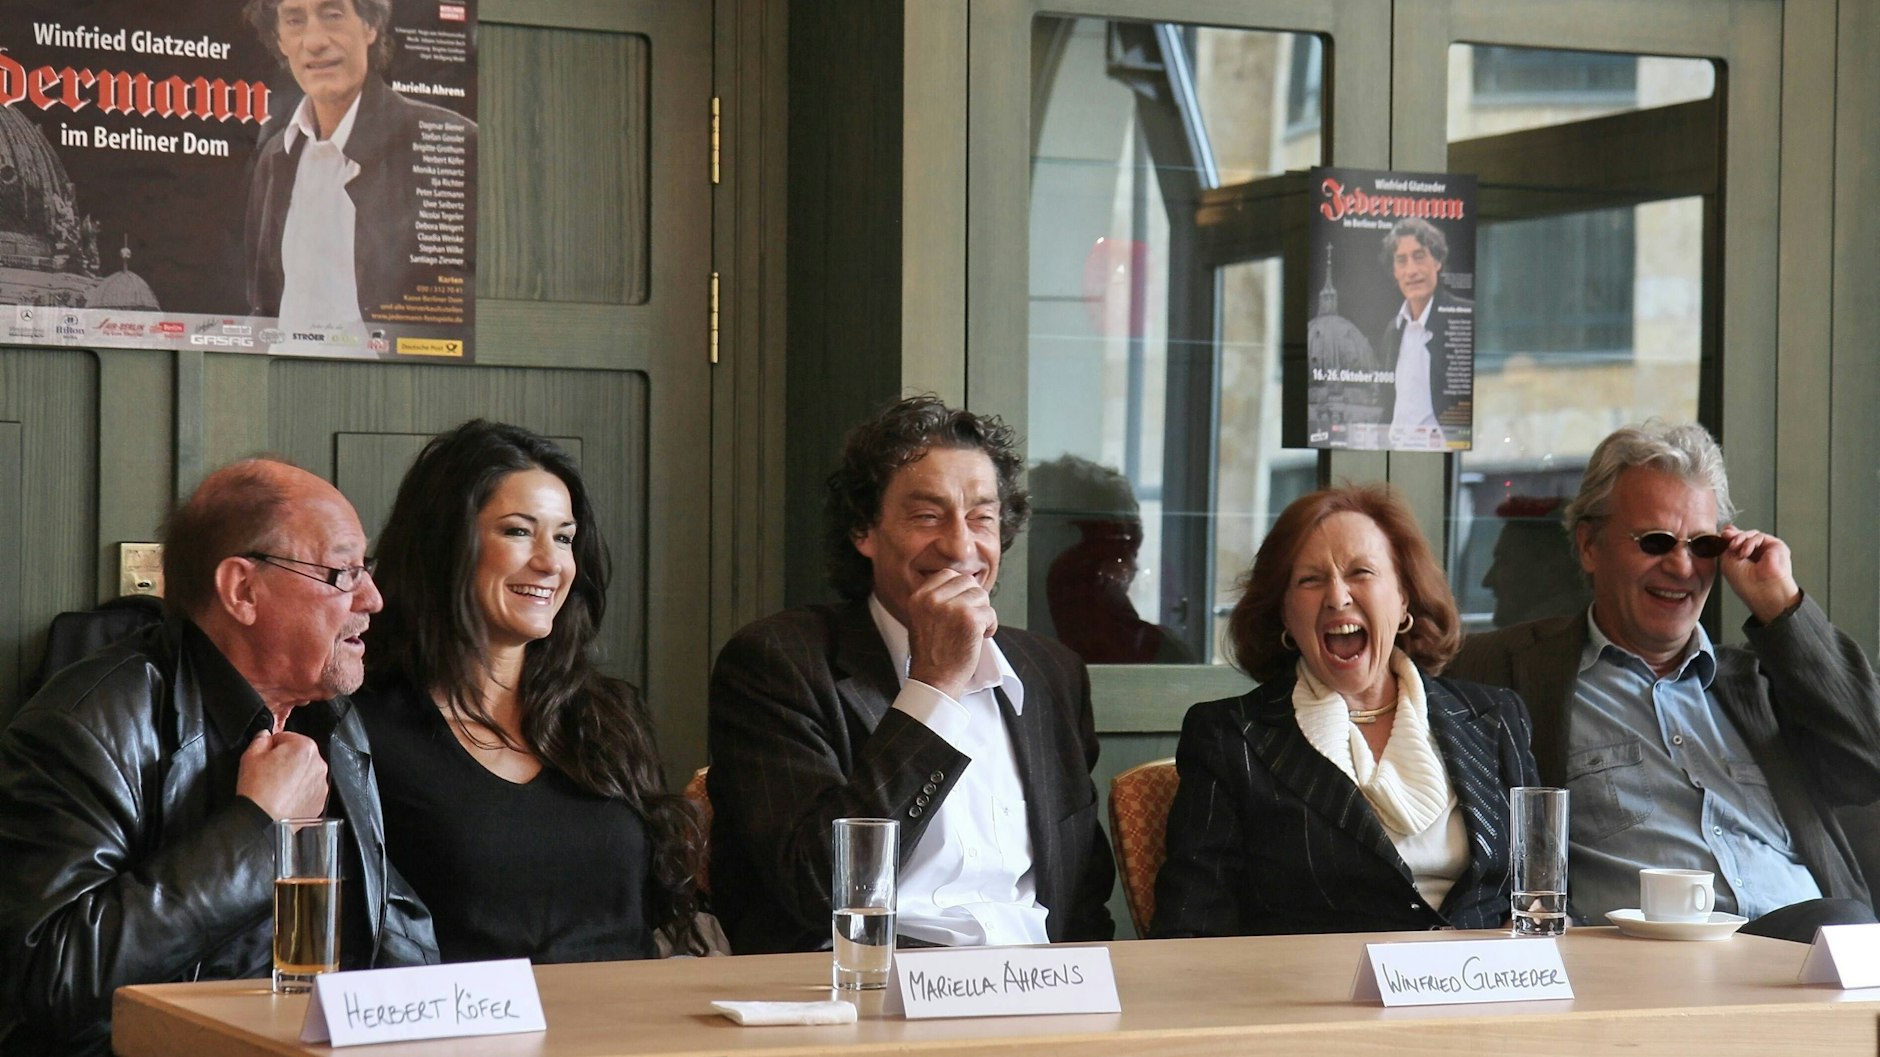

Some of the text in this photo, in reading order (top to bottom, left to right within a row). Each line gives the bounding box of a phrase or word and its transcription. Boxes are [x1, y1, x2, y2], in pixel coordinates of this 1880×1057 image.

[33, 22, 231, 59] Winfried Glatzeder
[392, 80, 465, 97] Mariella Ahrens
[60, 123, 230, 157] im Berliner Dom
[422, 155, 447, 164] Herbert
[412, 164, 436, 175] Monika
[442, 178, 464, 188] Richter
[1375, 179, 1446, 193] Winfried Glatzeder
[416, 187, 432, 196] Peter
[423, 199, 437, 208] Uwe
[1320, 177, 1464, 222] Jedermann
[1353, 218, 1377, 229] Berliner
[1378, 220, 1393, 229] Dom
[417, 232, 441, 242] Claudia
[438, 275, 464, 284] Karten
[56, 326, 85, 335] Hilton
[190, 334, 254, 347] GASAG
[292, 332, 325, 342] STRÖER
[1341, 370, 1373, 382] Oktober
[1374, 372, 1395, 383] 2008
[1003, 960, 1084, 993] AHRENS
[1462, 956, 1566, 991] GLATZEDER
[344, 991, 447, 1029] HERBERT
